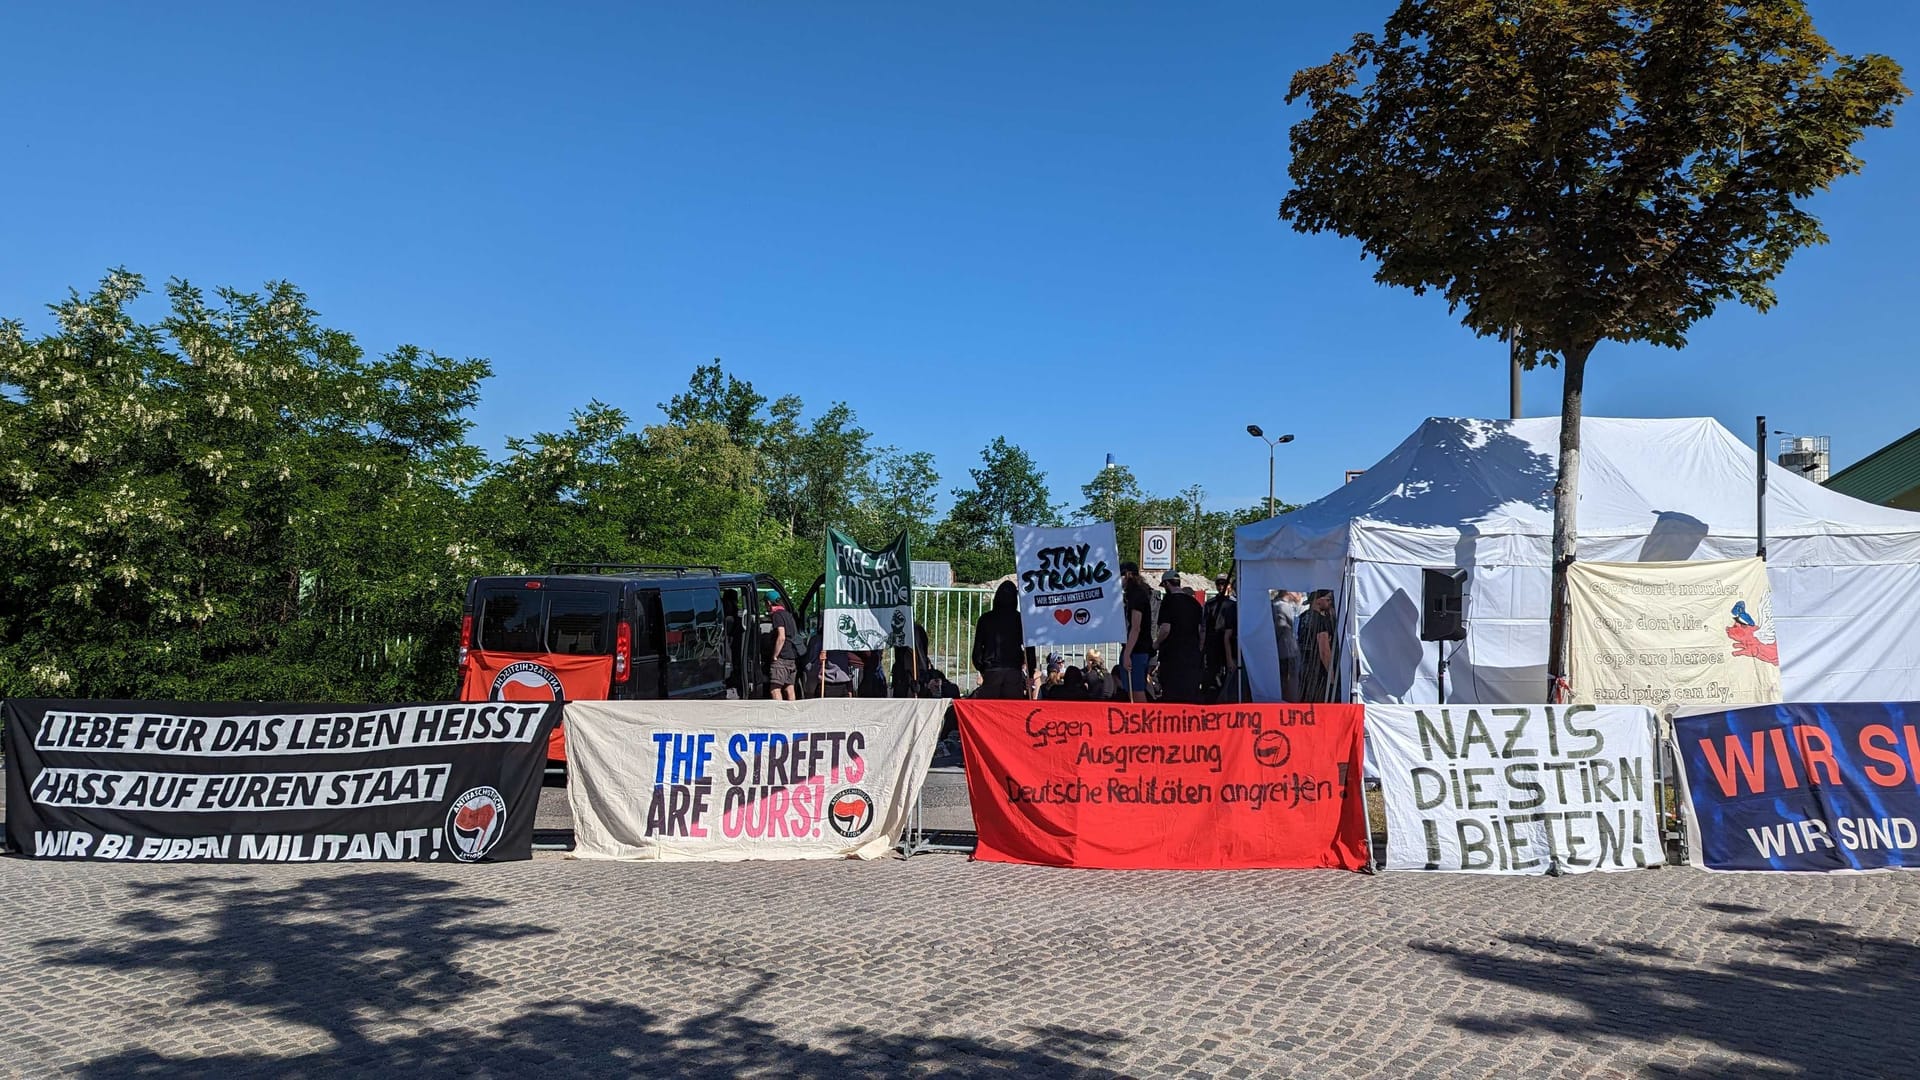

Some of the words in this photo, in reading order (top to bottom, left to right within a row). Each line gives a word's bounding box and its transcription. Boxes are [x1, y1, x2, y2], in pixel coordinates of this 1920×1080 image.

[836, 542, 872, 577] FREE
[1037, 543, 1090, 569] STAY
[1152, 539, 1163, 550] 10
[1022, 561, 1112, 592] STRONG
[1632, 579, 1676, 595] don't
[1679, 580, 1743, 597] murder,
[1636, 614, 1680, 630] don't
[1594, 653, 1634, 669] cops
[1639, 653, 1667, 665] are
[1671, 648, 1724, 665] heroes
[1594, 684, 1629, 700] and
[1633, 685, 1670, 705] pigs
[1674, 687, 1704, 700] can
[1706, 682, 1734, 703] fly.
[38, 715, 133, 749] LIEBE
[135, 717, 208, 751] FÜR
[211, 718, 285, 752] DAS
[286, 712, 406, 750] LEBEN
[412, 706, 540, 743] HEISST
[1026, 708, 1093, 747] Gegen
[1108, 707, 1262, 734] Diskriminierung
[1280, 704, 1315, 726] und
[1415, 705, 1604, 760] NAZIS
[653, 733, 715, 785] THE
[727, 731, 865, 785] STREETS
[1076, 741, 1221, 772] Ausgrenzung
[1698, 724, 1842, 797] WIR
[33, 772, 122, 805] HASS
[120, 776, 198, 808] AUF
[197, 775, 322, 809] EUREN
[326, 767, 446, 805] STAAT
[1006, 776, 1102, 804] Deutsche
[1107, 775, 1211, 804] Realitäten
[645, 784, 708, 838] ARE
[722, 784, 826, 838] OURS!
[34, 830, 93, 857] WIR
[239, 828, 442, 861] MILITANT!
[1747, 819, 1835, 859] WIR
[1837, 817, 1917, 850] SIND
